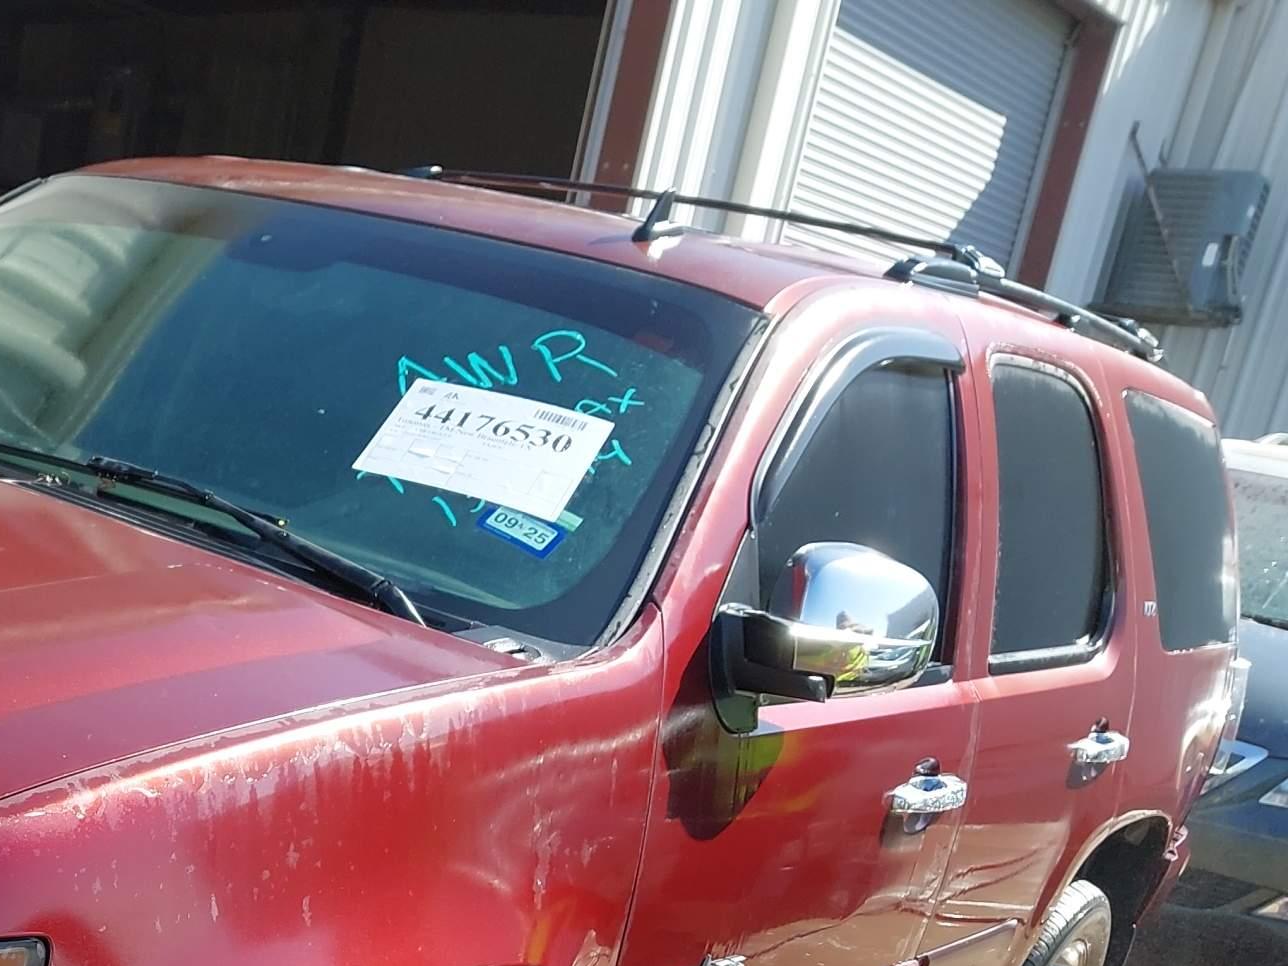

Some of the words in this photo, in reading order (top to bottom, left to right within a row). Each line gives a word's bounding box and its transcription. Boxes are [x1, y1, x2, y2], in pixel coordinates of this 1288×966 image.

[414, 402, 573, 454] 44176530
[494, 512, 520, 529] 09
[523, 527, 550, 545] 25
